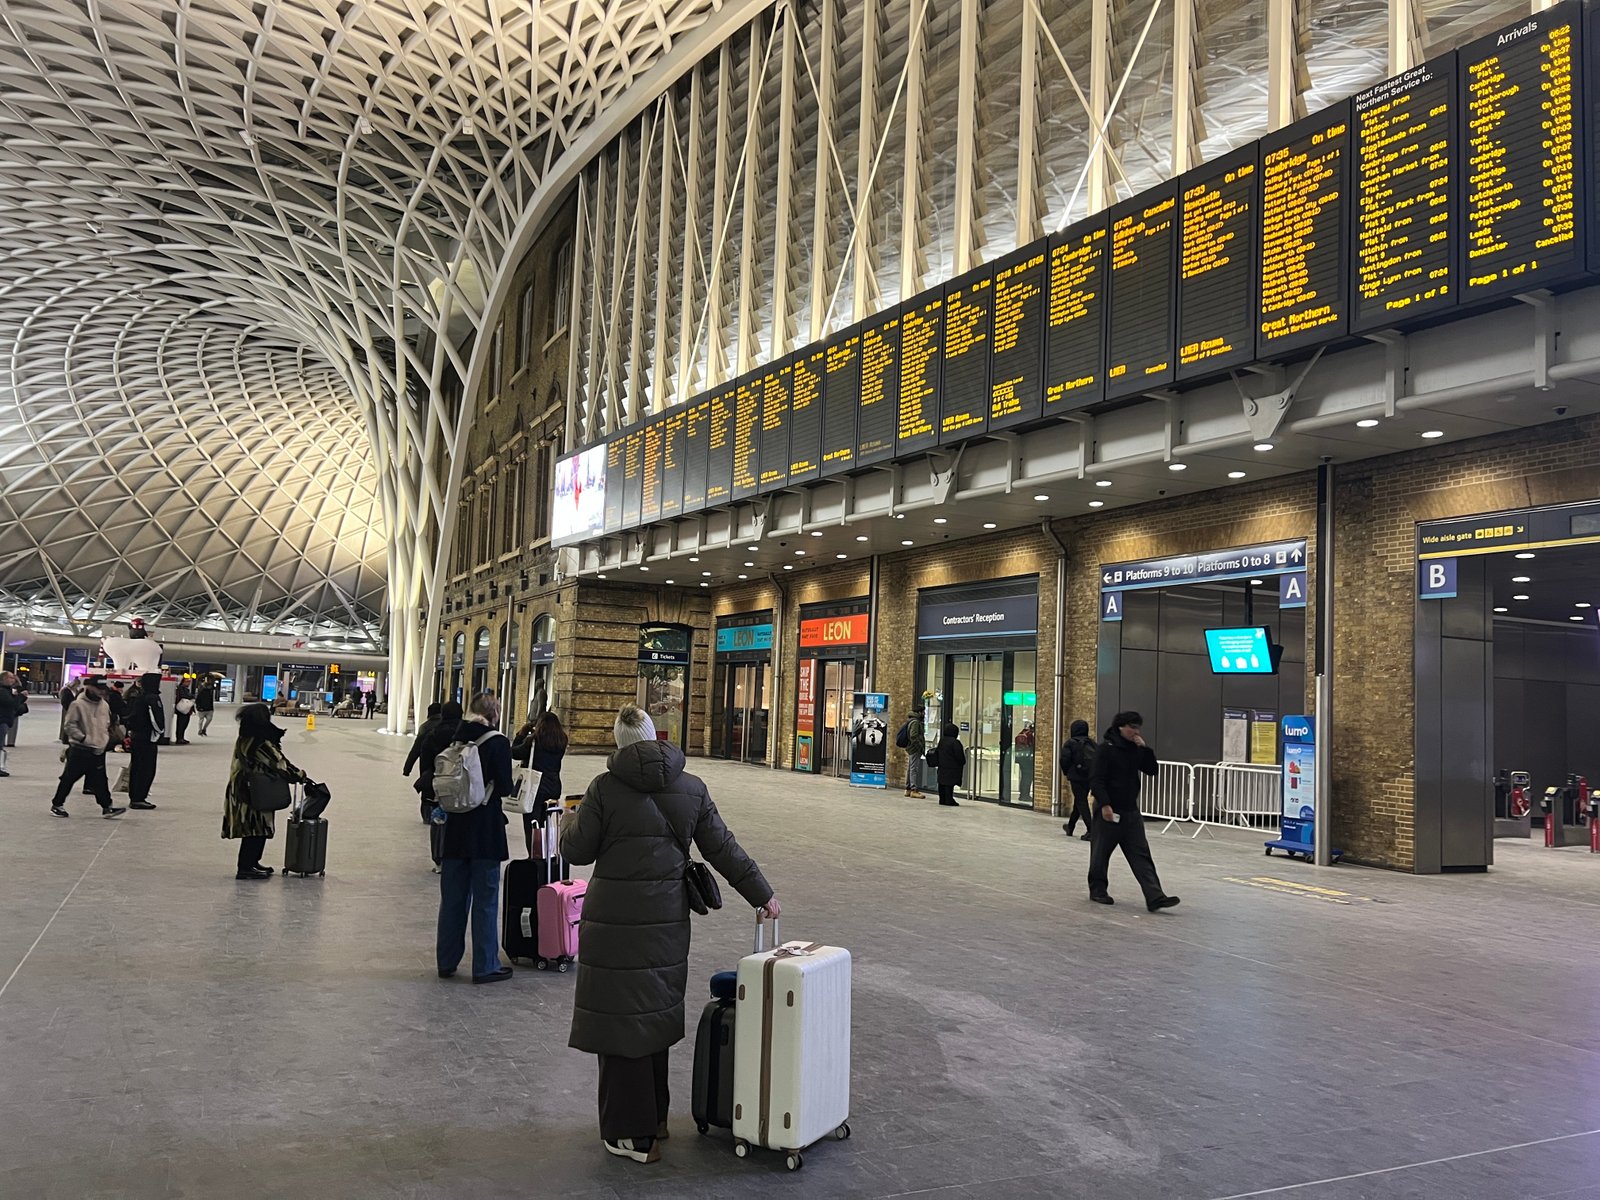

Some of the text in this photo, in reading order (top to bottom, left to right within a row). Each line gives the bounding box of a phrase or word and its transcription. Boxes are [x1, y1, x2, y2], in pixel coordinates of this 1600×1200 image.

[1497, 21, 1537, 46] Arrivals
[1469, 57, 1498, 73] Royston
[1356, 66, 1425, 102] Next Fastest Great
[1470, 73, 1505, 91] Cambridge
[1356, 73, 1433, 111] Northern Service to:
[1470, 85, 1519, 110] Peterborough
[1470, 110, 1505, 128] Cambridge
[1327, 125, 1345, 138] time
[1361, 120, 1389, 137] Baldock
[1470, 135, 1487, 146] York
[1265, 154, 1307, 177] Cambridge
[1361, 152, 1398, 171] Cambridge
[1470, 148, 1505, 165] Cambridge
[1361, 173, 1390, 188] Downham
[1393, 161, 1418, 175] Market
[1470, 167, 1506, 183] Cambridge
[1361, 196, 1373, 205] Ely
[1470, 182, 1513, 202] Letchworth
[1184, 191, 1220, 212] Newcastle
[1360, 206, 1394, 223] Finsbury
[1396, 198, 1414, 210] Park
[1470, 199, 1520, 220] Peterborough
[1114, 222, 1145, 241] Edinburgh
[1360, 223, 1391, 240] Hatfield
[1470, 227, 1491, 239] Leeds
[1536, 231, 1573, 248] Cancelled
[1360, 243, 1388, 257] Hitchin
[1470, 242, 1508, 258] Doncaster
[1360, 256, 1401, 274] Huntingdon
[1470, 261, 1537, 286] Page 1 of 1
[1383, 274, 1401, 284] Lynn
[1386, 298, 1410, 310] Page
[1424, 289, 1436, 299] of
[1262, 317, 1286, 332] Great
[1289, 306, 1330, 325] Northern
[1181, 337, 1224, 357] LNER Azuma
[1423, 532, 1472, 544] Wide aisle gate
[1126, 564, 1194, 581] Platforms 9 to 10
[1198, 554, 1270, 573] Platforms 0 to 8
[1429, 564, 1446, 588] B
[1286, 577, 1301, 599] A
[1106, 596, 1117, 614] A
[976, 612, 1004, 623] Reception
[734, 630, 754, 646] LEON
[823, 621, 851, 640] LEON
[1285, 725, 1308, 736] lumo
